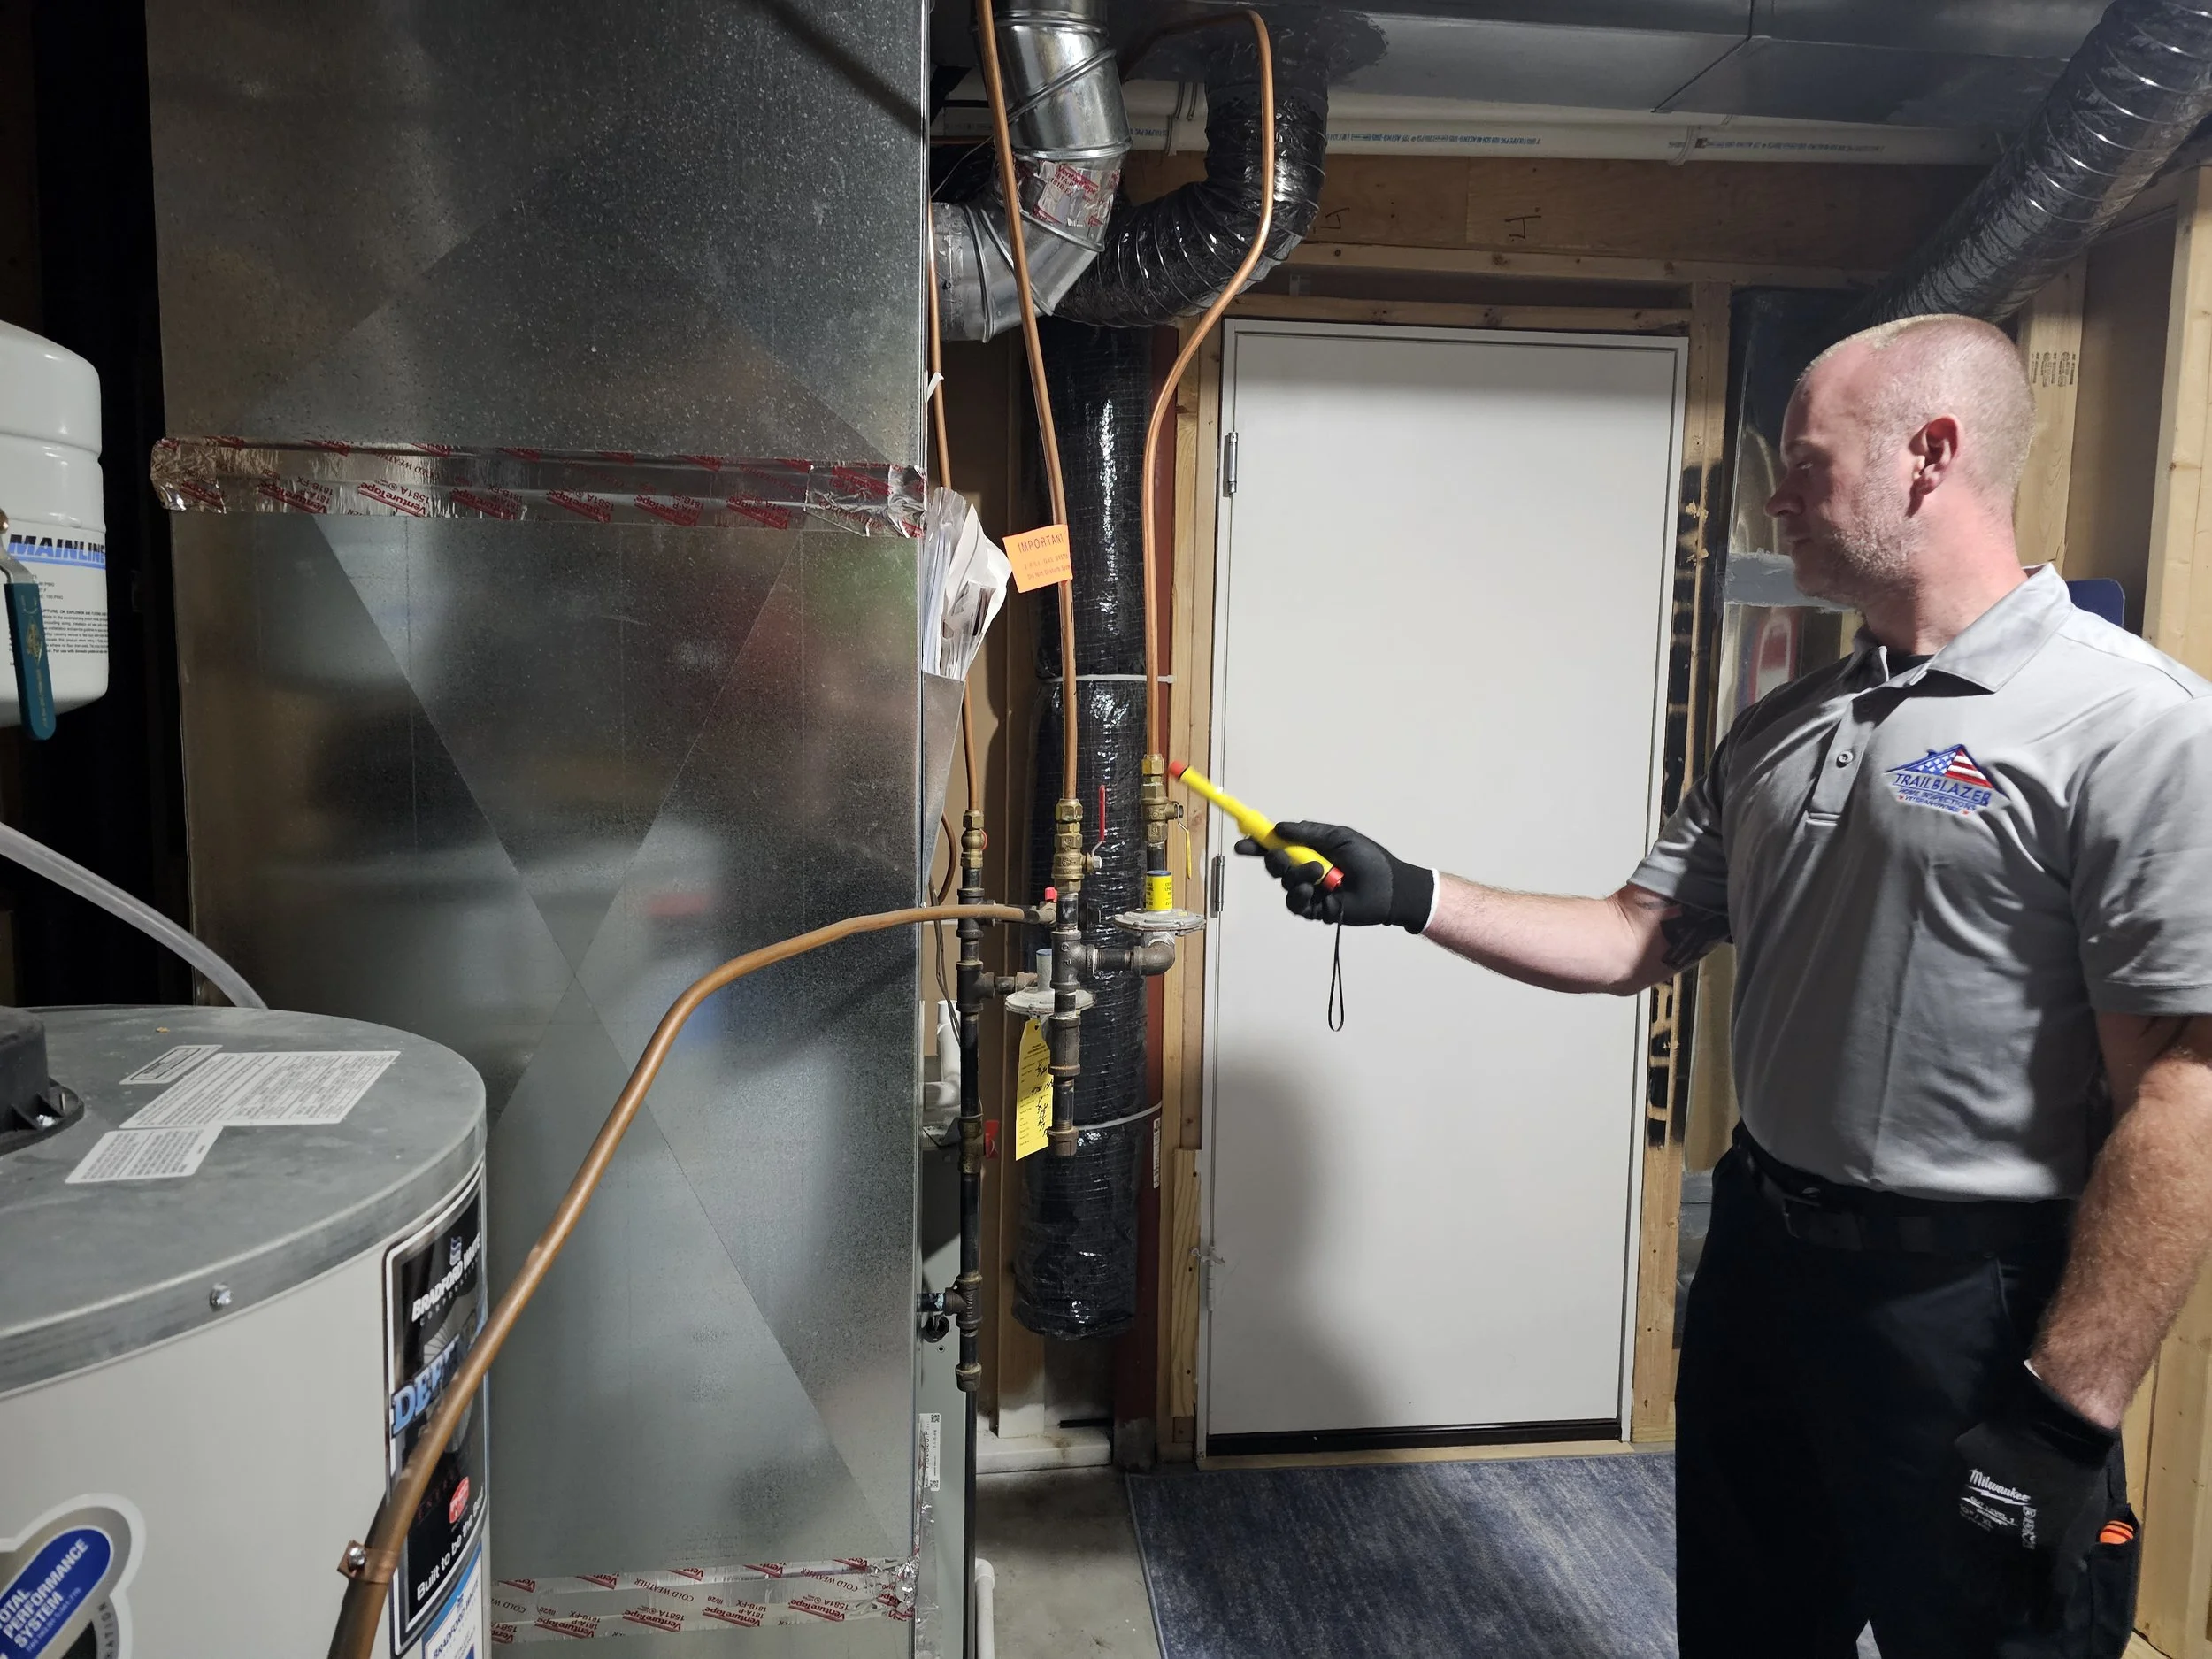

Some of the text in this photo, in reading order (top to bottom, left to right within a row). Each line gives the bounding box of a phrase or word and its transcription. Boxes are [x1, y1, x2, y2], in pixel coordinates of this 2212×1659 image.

[357, 482, 426, 516] VentureTape
[400, 486, 430, 503] 1581A
[1018, 534, 1064, 553] IMPORTANT
[1893, 772, 1993, 807] TRAILBLAZER
[411, 1260, 464, 1323] BRADFORD
[1969, 1468, 2032, 1502] Milwaukee
[416, 1564, 441, 1602] Built
[441, 1552, 451, 1571] to
[450, 1534, 463, 1556] be
[462, 1517, 474, 1539] the
[3, 1538, 90, 1640] PERFORMANCE
[634, 1578, 695, 1602] COLD WEATHER
[800, 1567, 858, 1592] COLD WEATHER
[502, 1601, 526, 1614] COLD
[659, 1609, 685, 1621] 1581A
[735, 1600, 767, 1612] 181B-FX
[738, 1609, 764, 1619] 181A-P
[787, 1599, 845, 1621] VentureTape
[824, 1599, 849, 1610] 1581A
[13, 1591, 65, 1649] SYSTEM
[568, 1610, 601, 1624] 181B-FX
[572, 1619, 598, 1630] 181A-P
[622, 1609, 681, 1630] VentureTape
[702, 1606, 761, 1627] VentureTape
[534, 1617, 595, 1638] VentureTape
